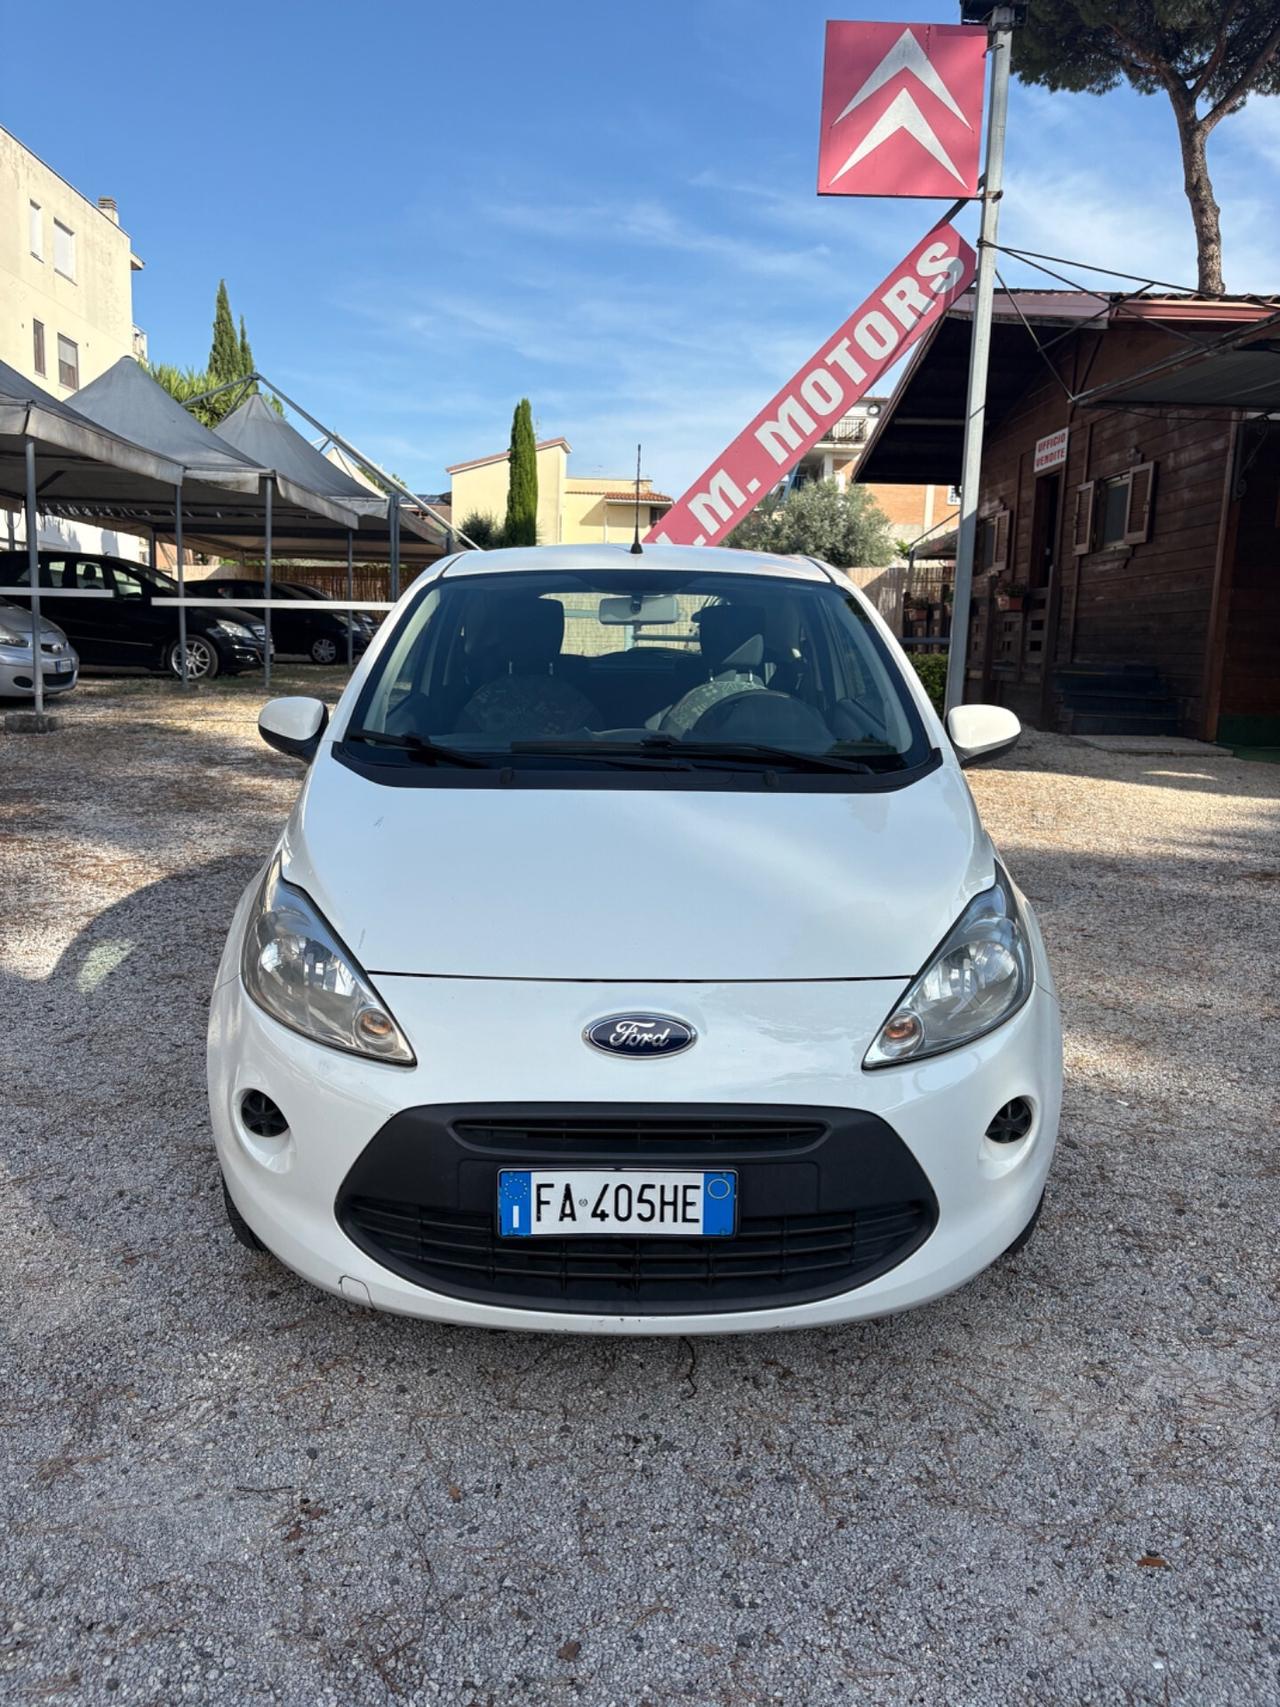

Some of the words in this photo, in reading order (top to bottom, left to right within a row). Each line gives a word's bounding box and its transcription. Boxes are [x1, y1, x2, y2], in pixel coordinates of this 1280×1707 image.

[655, 468, 761, 545] .M.
[754, 241, 964, 466] MOTORS
[1038, 432, 1066, 453] UFFICIO
[1036, 448, 1066, 467] VENDITE
[609, 1020, 671, 1047] Ford
